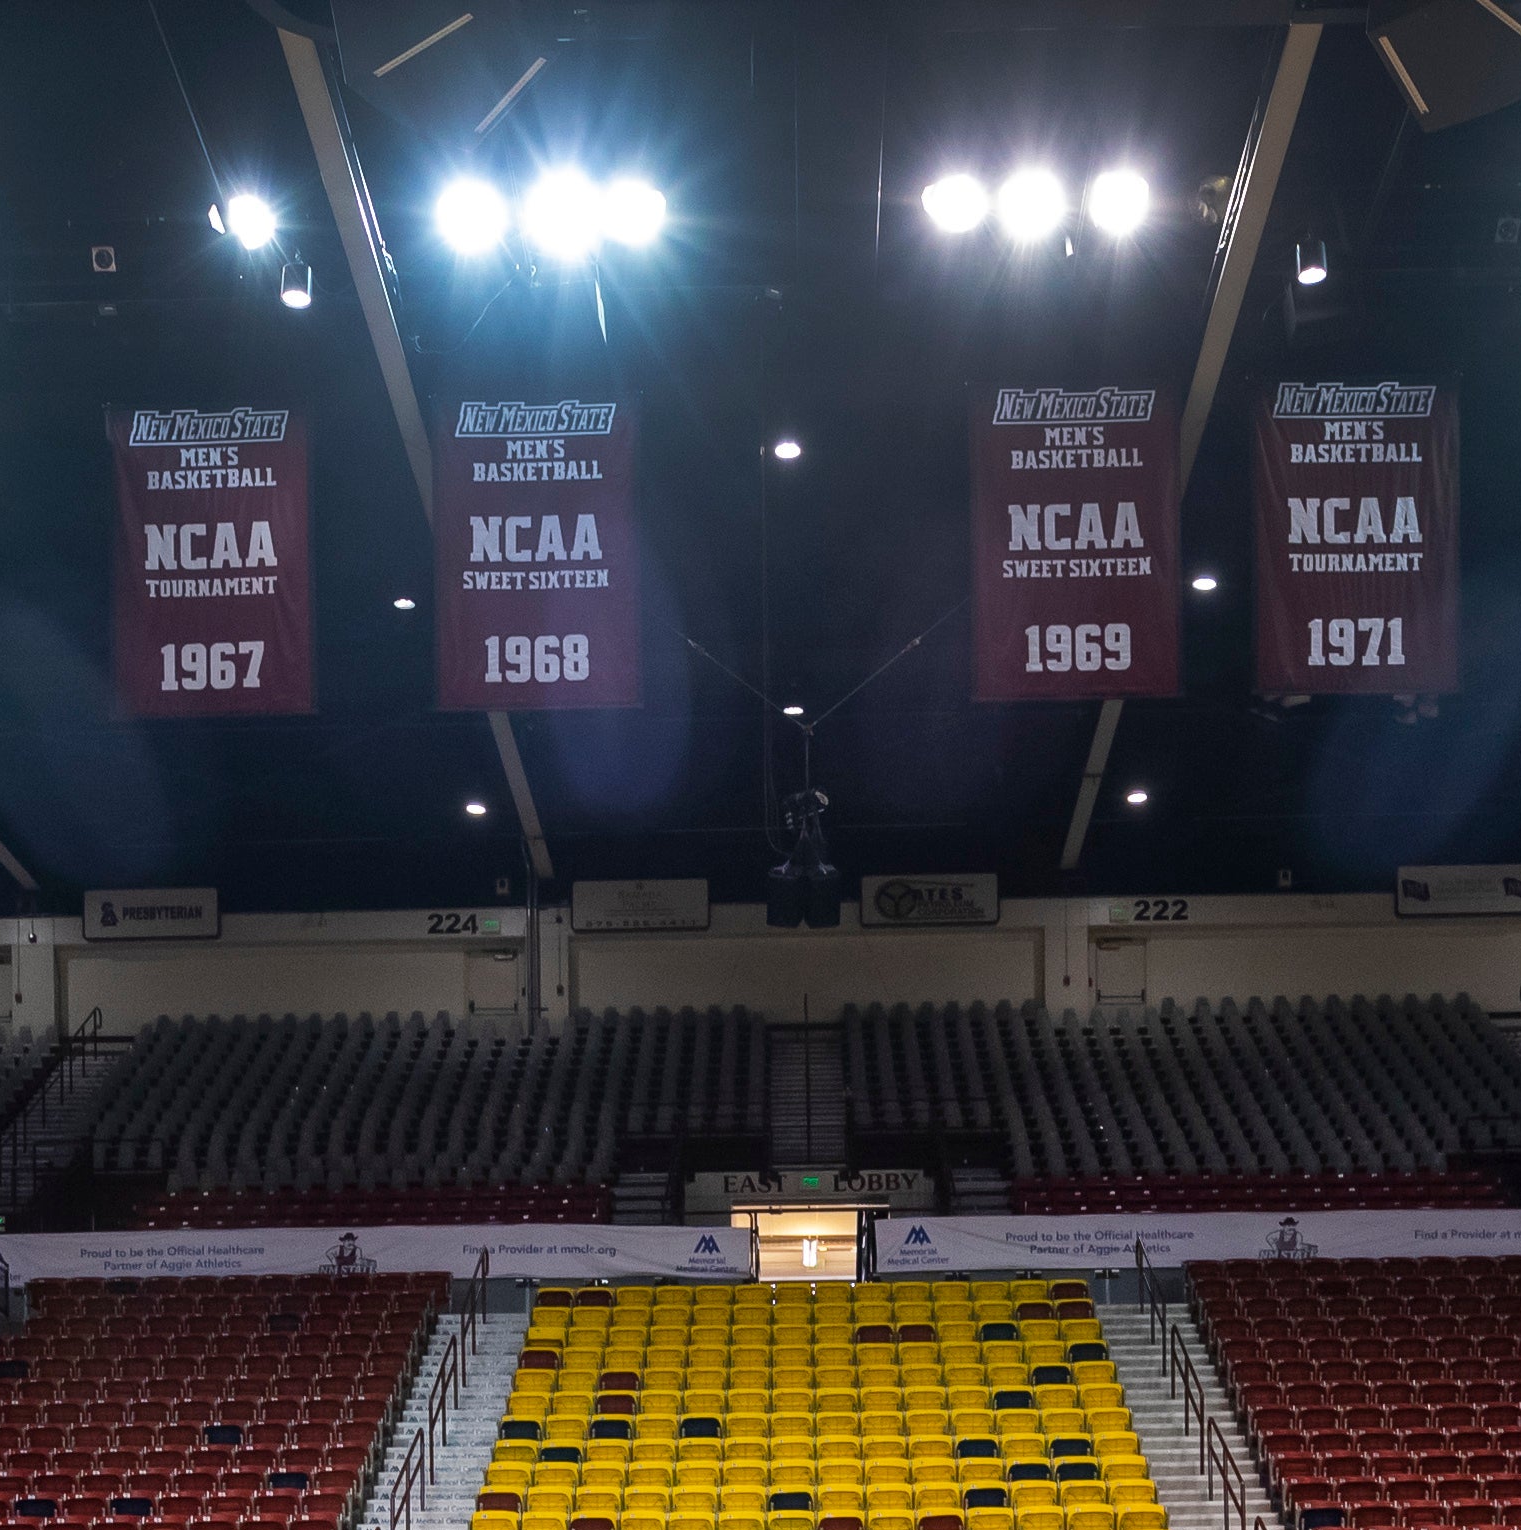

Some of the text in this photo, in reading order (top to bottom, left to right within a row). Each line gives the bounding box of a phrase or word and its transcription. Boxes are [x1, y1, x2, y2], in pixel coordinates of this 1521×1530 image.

[1044, 427, 1104, 446] MEN'S
[1325, 422, 1384, 440] MEN'S
[181, 447, 239, 467] MEN'S
[506, 440, 565, 459] MEN'S
[1011, 448, 1143, 469] BASKETBALL
[1290, 443, 1422, 463] BASKETBALL
[147, 468, 276, 490] BASKETBALL
[473, 461, 603, 481] BASKETBALL
[1008, 502, 1144, 551] NCAA
[1288, 497, 1422, 544] NCAA
[145, 521, 278, 570] NCAA
[470, 514, 603, 562] NCAA
[1003, 557, 1151, 578] SWEET SIXTEEN
[1289, 553, 1423, 572] TOURNAMENT
[145, 576, 277, 597] TOURNAMENT
[463, 570, 609, 590] SWEET SIXTEEN
[1025, 623, 1131, 672] 1969
[1307, 617, 1405, 666] 1971
[161, 641, 264, 691] 1967
[484, 634, 589, 683] 1968
[122, 906, 202, 920] PRESBYTERIAN
[1133, 900, 1189, 921] 222
[427, 914, 478, 934] 224
[723, 1172, 919, 1193] EAST LOBBY
[1005, 1232, 1037, 1241] Proud
[1042, 1232, 1052, 1241] to
[1056, 1232, 1070, 1240] be
[1074, 1231, 1091, 1240] the
[1094, 1229, 1133, 1240] Official
[1414, 1229, 1436, 1239] Find
[1451, 1229, 1497, 1239] Provider
[80, 1245, 264, 1259] Proud to be the Official Healthcare
[498, 1244, 543, 1254] Provider
[547, 1245, 558, 1254] at
[1030, 1243, 1120, 1255] Partner of Aggie
[104, 1259, 242, 1272] Partner of Aggie Athletics
[687, 1256, 727, 1265] Memorial
[887, 1256, 949, 1265] Medical Center
